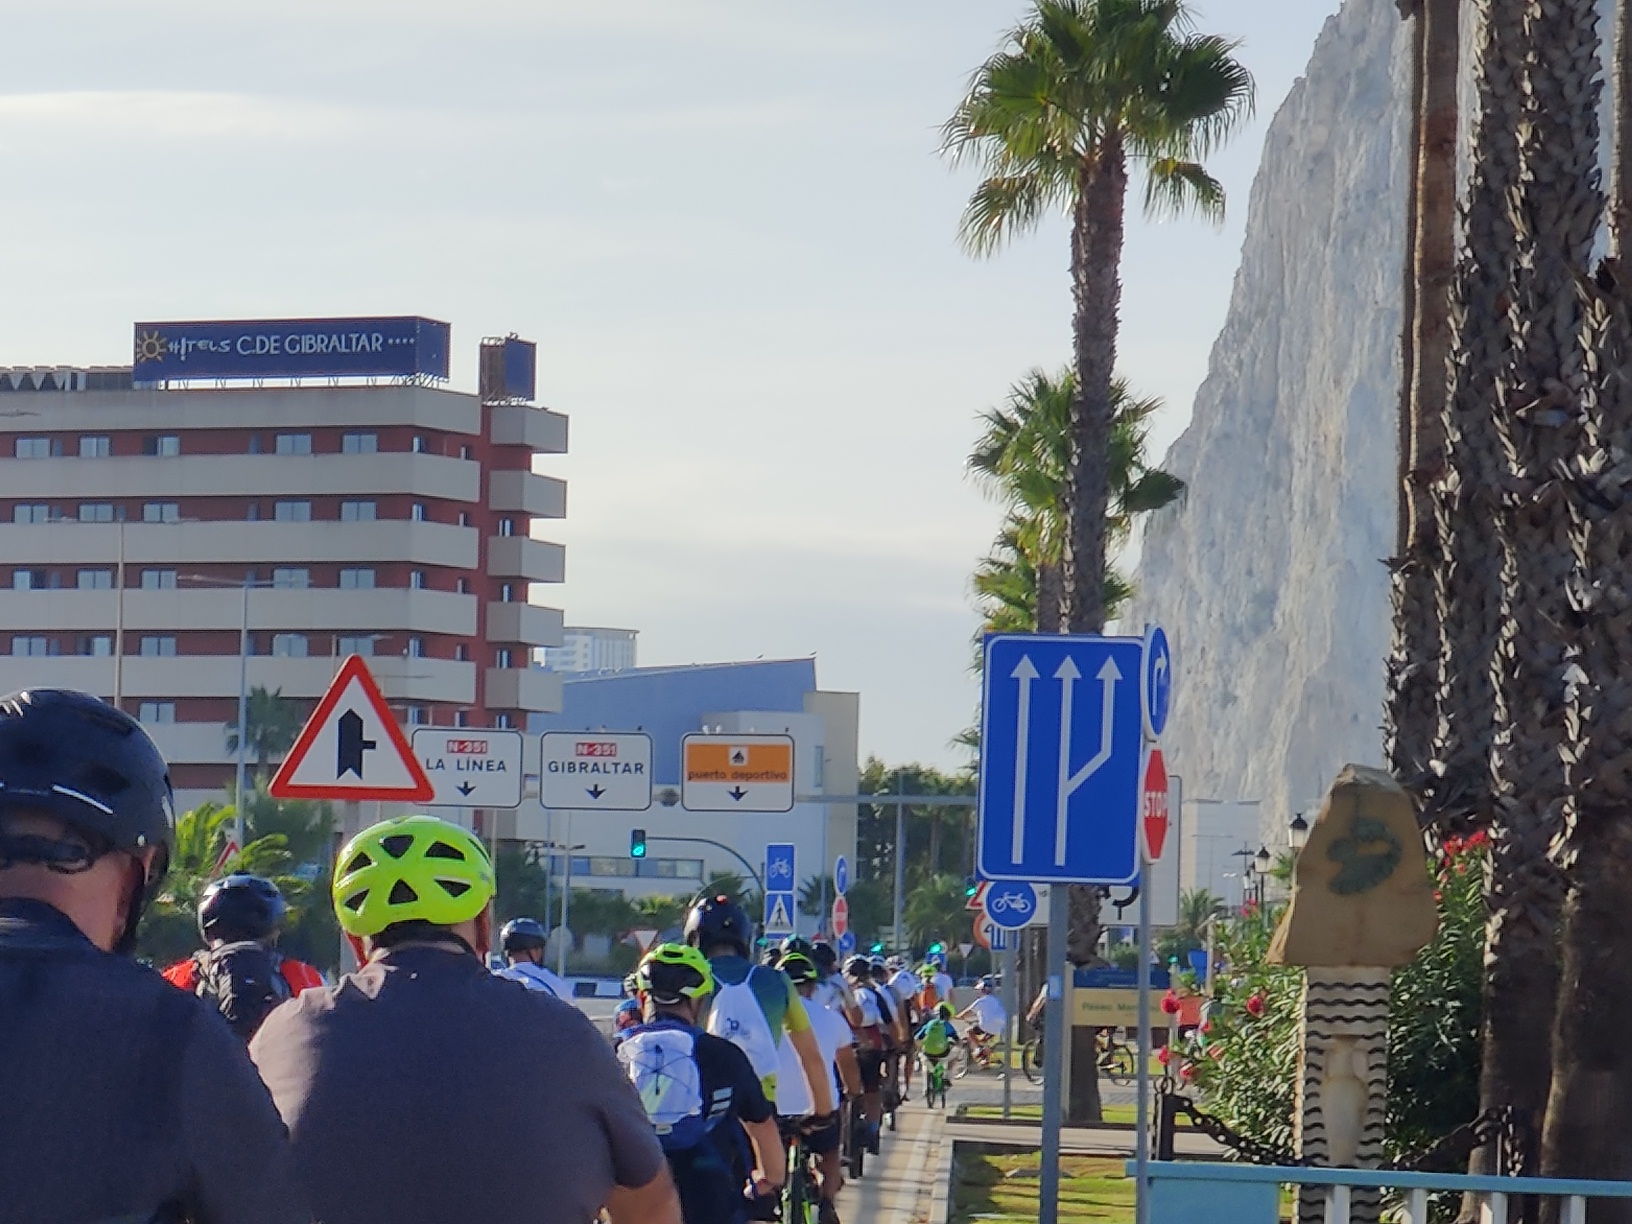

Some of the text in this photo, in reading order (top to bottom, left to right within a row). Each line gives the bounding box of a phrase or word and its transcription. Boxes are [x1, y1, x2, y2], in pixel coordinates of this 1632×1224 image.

[285, 333, 383, 354] GIBRALTAR
[426, 756, 506, 771] LA LÍNEA
[548, 761, 644, 774] GIBRALTAR
[688, 770, 788, 782] puerto deportivo
[1144, 792, 1167, 817] STOP
